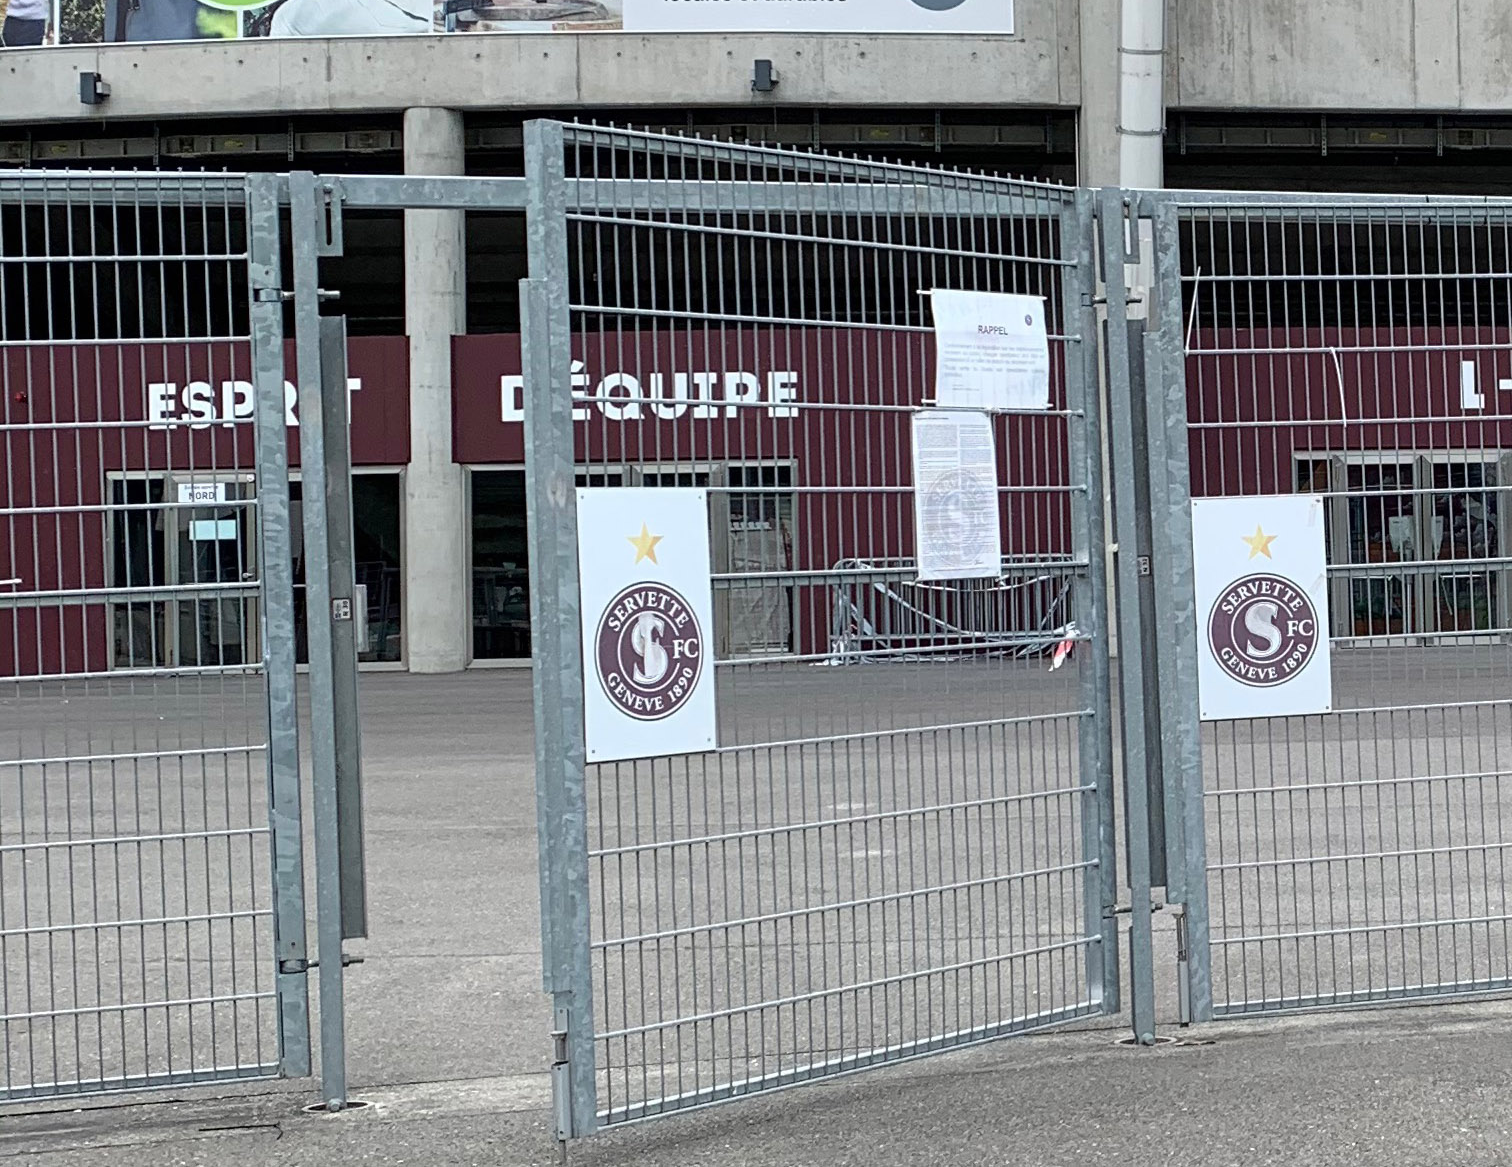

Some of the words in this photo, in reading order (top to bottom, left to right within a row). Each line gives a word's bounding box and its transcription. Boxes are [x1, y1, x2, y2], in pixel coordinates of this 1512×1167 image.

[978, 324, 1008, 335] RAPPEL
[501, 360, 799, 422] DÉQUIPE
[608, 590, 690, 632] SERVETTE
[1220, 581, 1304, 615] SERVETTE
[631, 611, 669, 685] S
[1244, 601, 1282, 658] S
[1286, 619, 1314, 638] FC
[673, 637, 699, 660] FC
[1220, 646, 1278, 680] GENEVE
[1282, 644, 1308, 674] 1890
[607, 671, 665, 712] GENEVE
[668, 666, 694, 704] 1890
